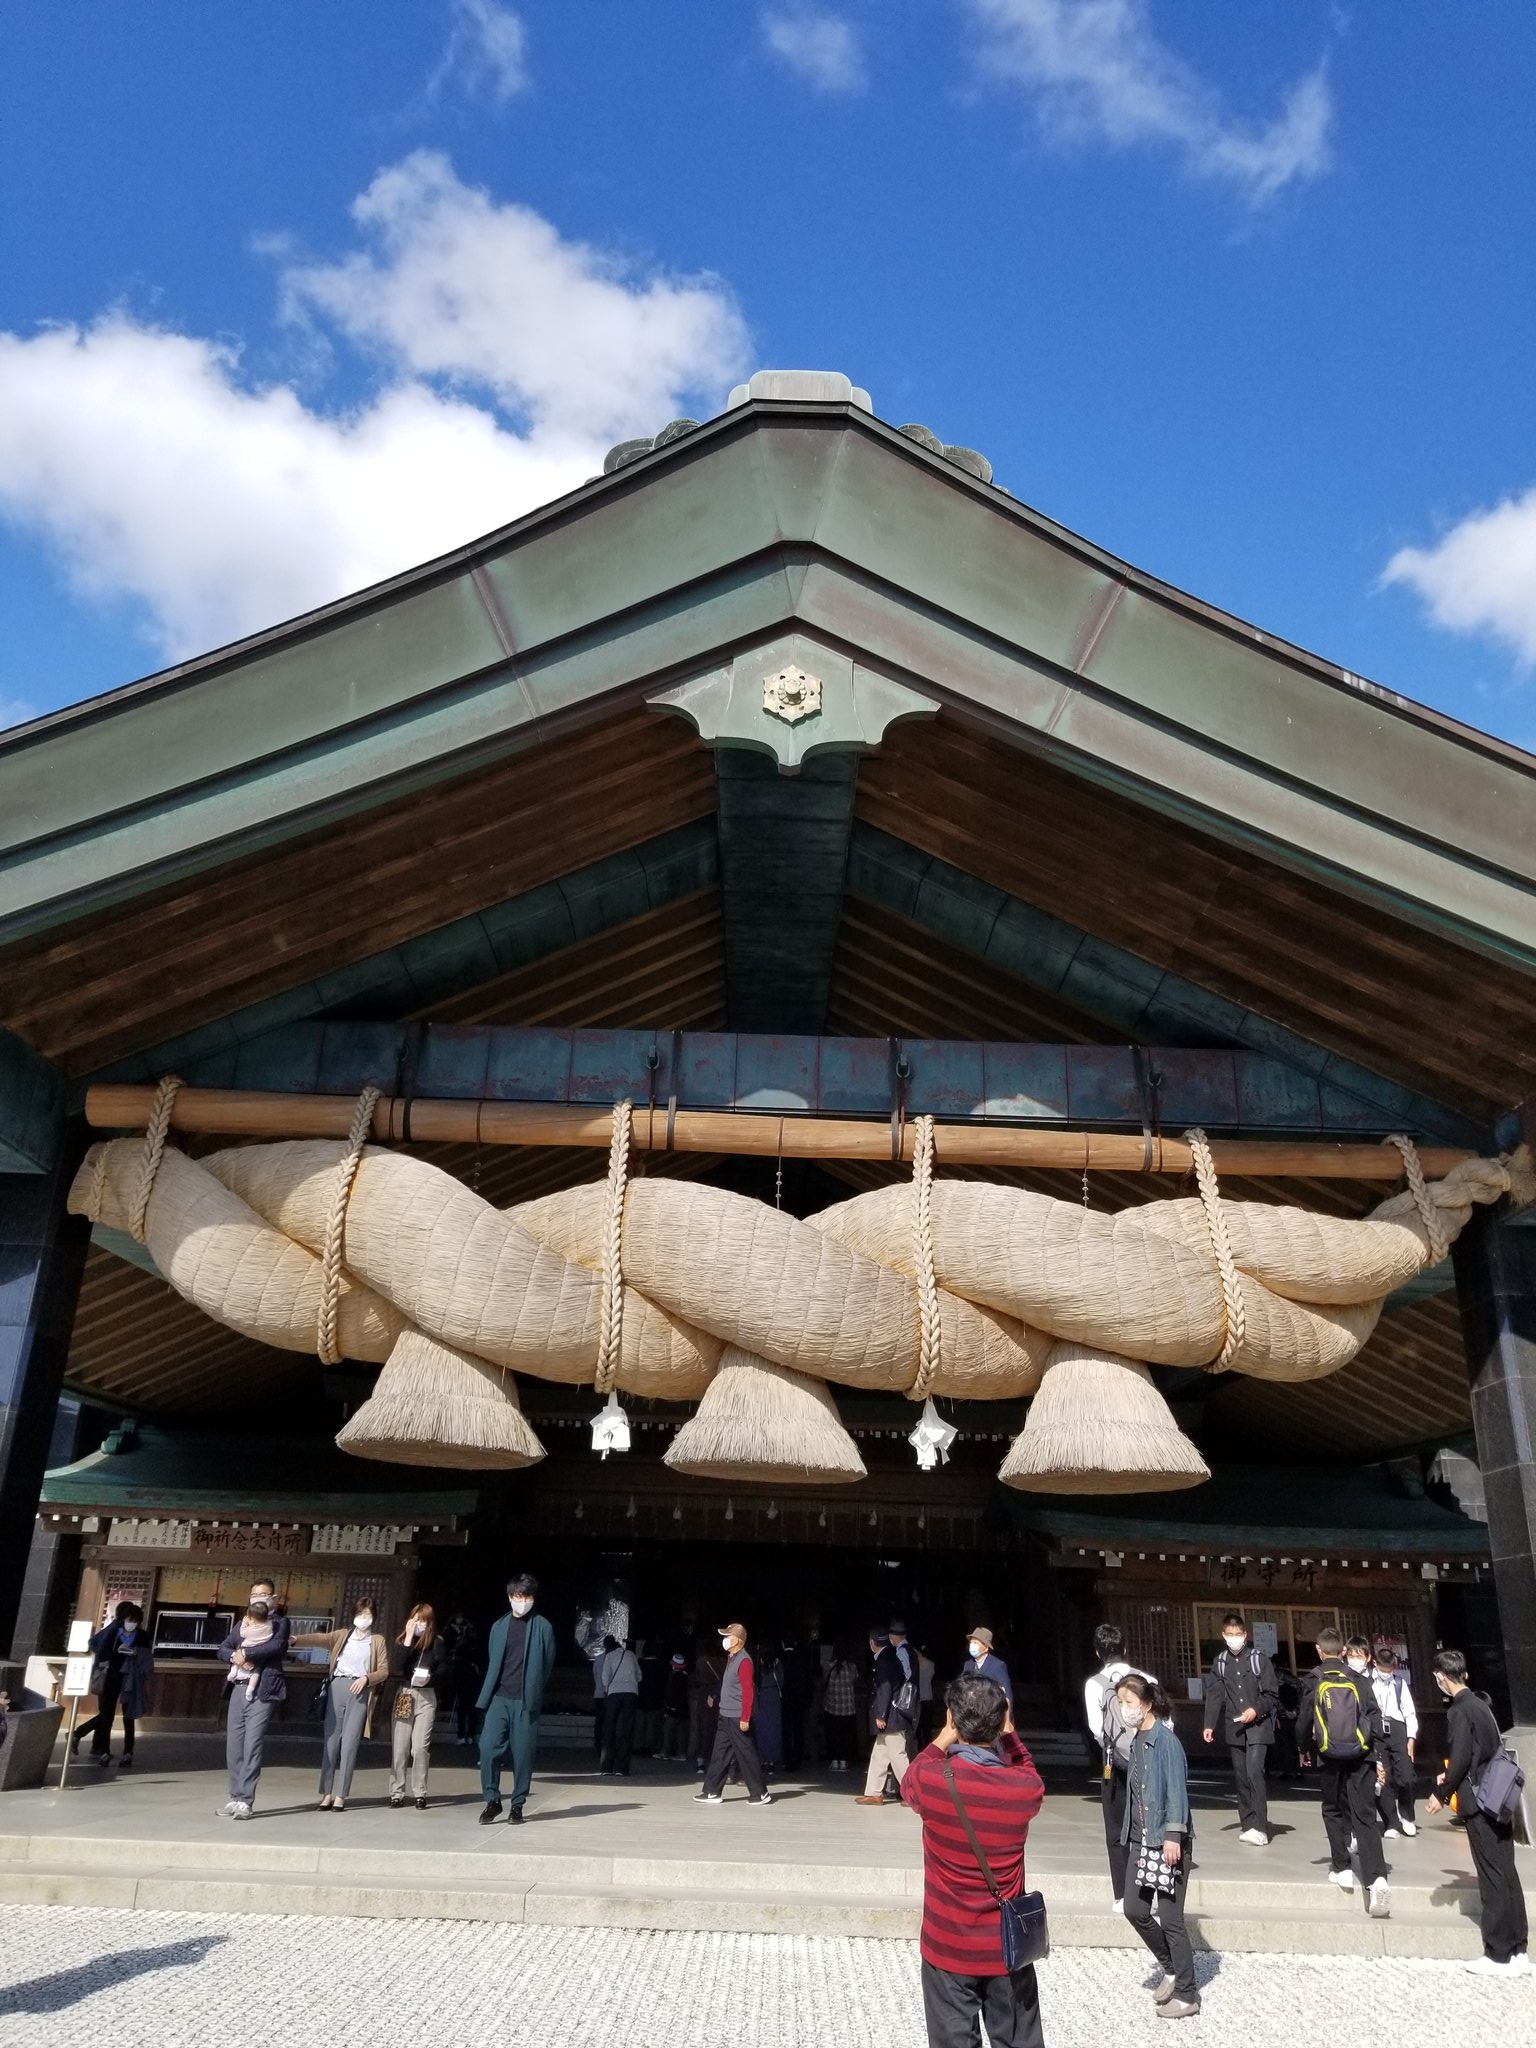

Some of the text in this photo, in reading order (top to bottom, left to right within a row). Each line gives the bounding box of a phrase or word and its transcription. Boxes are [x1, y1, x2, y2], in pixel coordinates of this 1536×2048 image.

[194, 1528, 302, 1552] 御祈念受付所
[1221, 1563, 1318, 1588] 御守所
